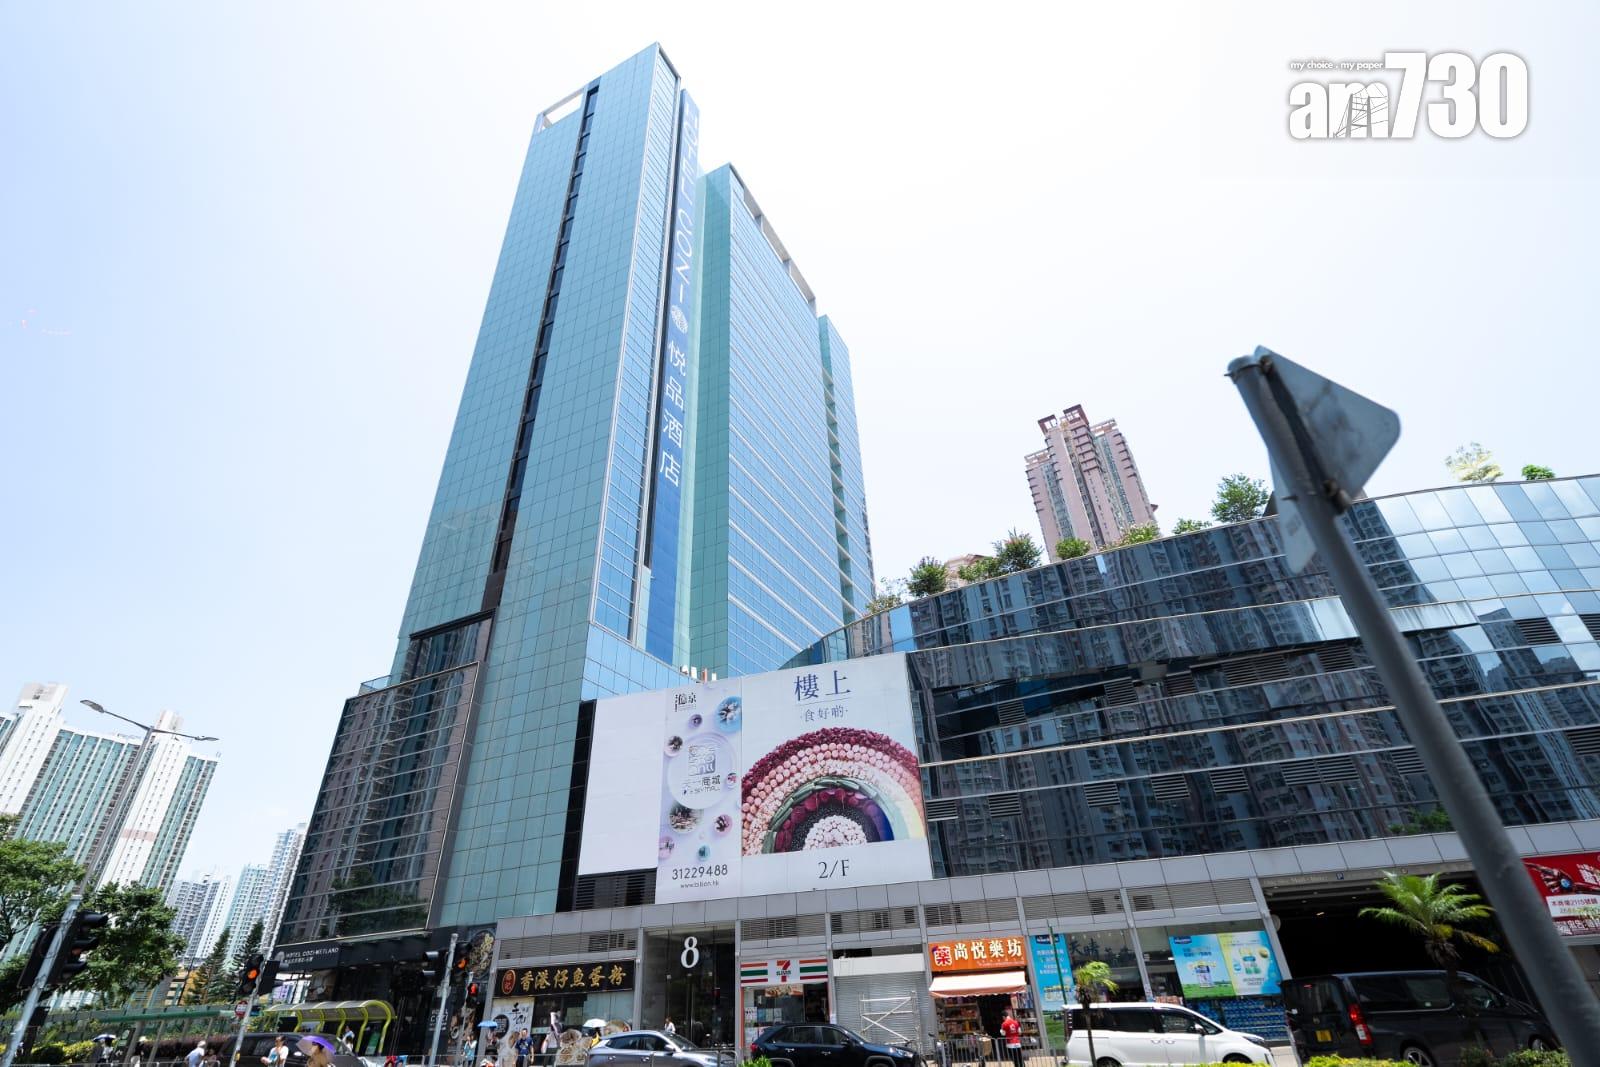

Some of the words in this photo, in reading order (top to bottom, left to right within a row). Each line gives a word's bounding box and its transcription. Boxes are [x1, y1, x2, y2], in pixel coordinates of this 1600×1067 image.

[794, 670, 852, 701] 樓上
[672, 864, 728, 880] 31229488
[817, 859, 851, 879] 2/F
[681, 936, 699, 968] 8
[520, 964, 627, 992] 香港仔魚蛋粉
